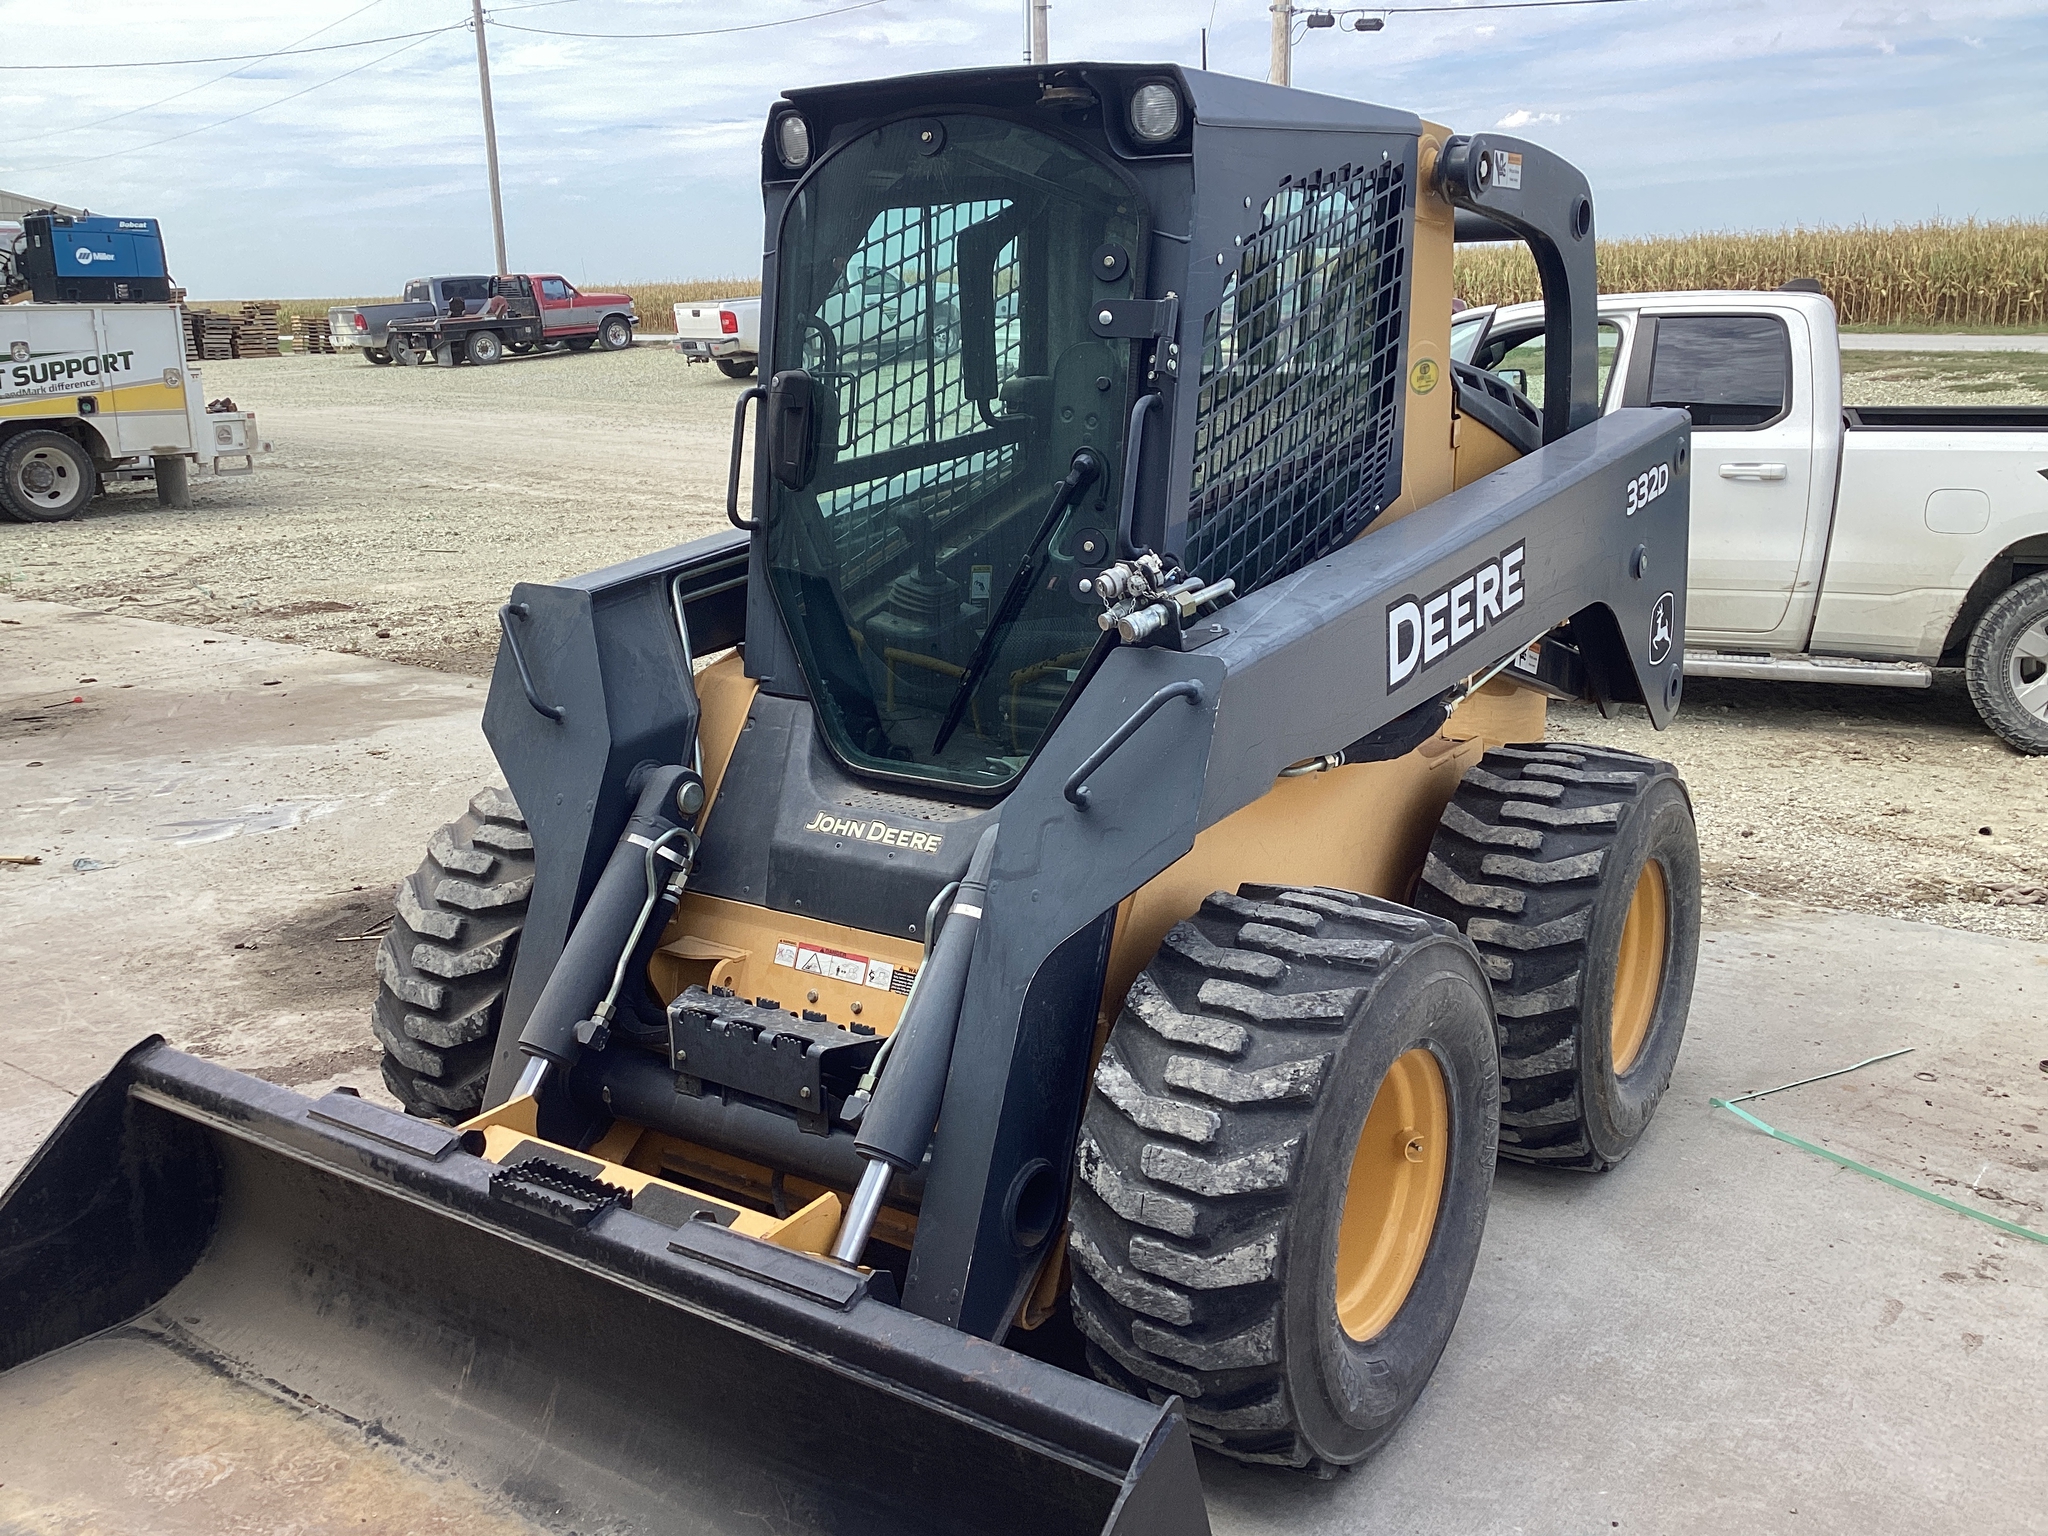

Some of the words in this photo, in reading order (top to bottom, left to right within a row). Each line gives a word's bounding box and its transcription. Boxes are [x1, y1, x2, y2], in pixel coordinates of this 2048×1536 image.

[119, 221, 147, 229] Bobcat
[12, 350, 134, 387] SUPPORT
[1626, 462, 1669, 516] 332D
[1389, 545, 1524, 687] DEERE
[805, 811, 867, 839] JOHN
[865, 820, 943, 852] DEERE
